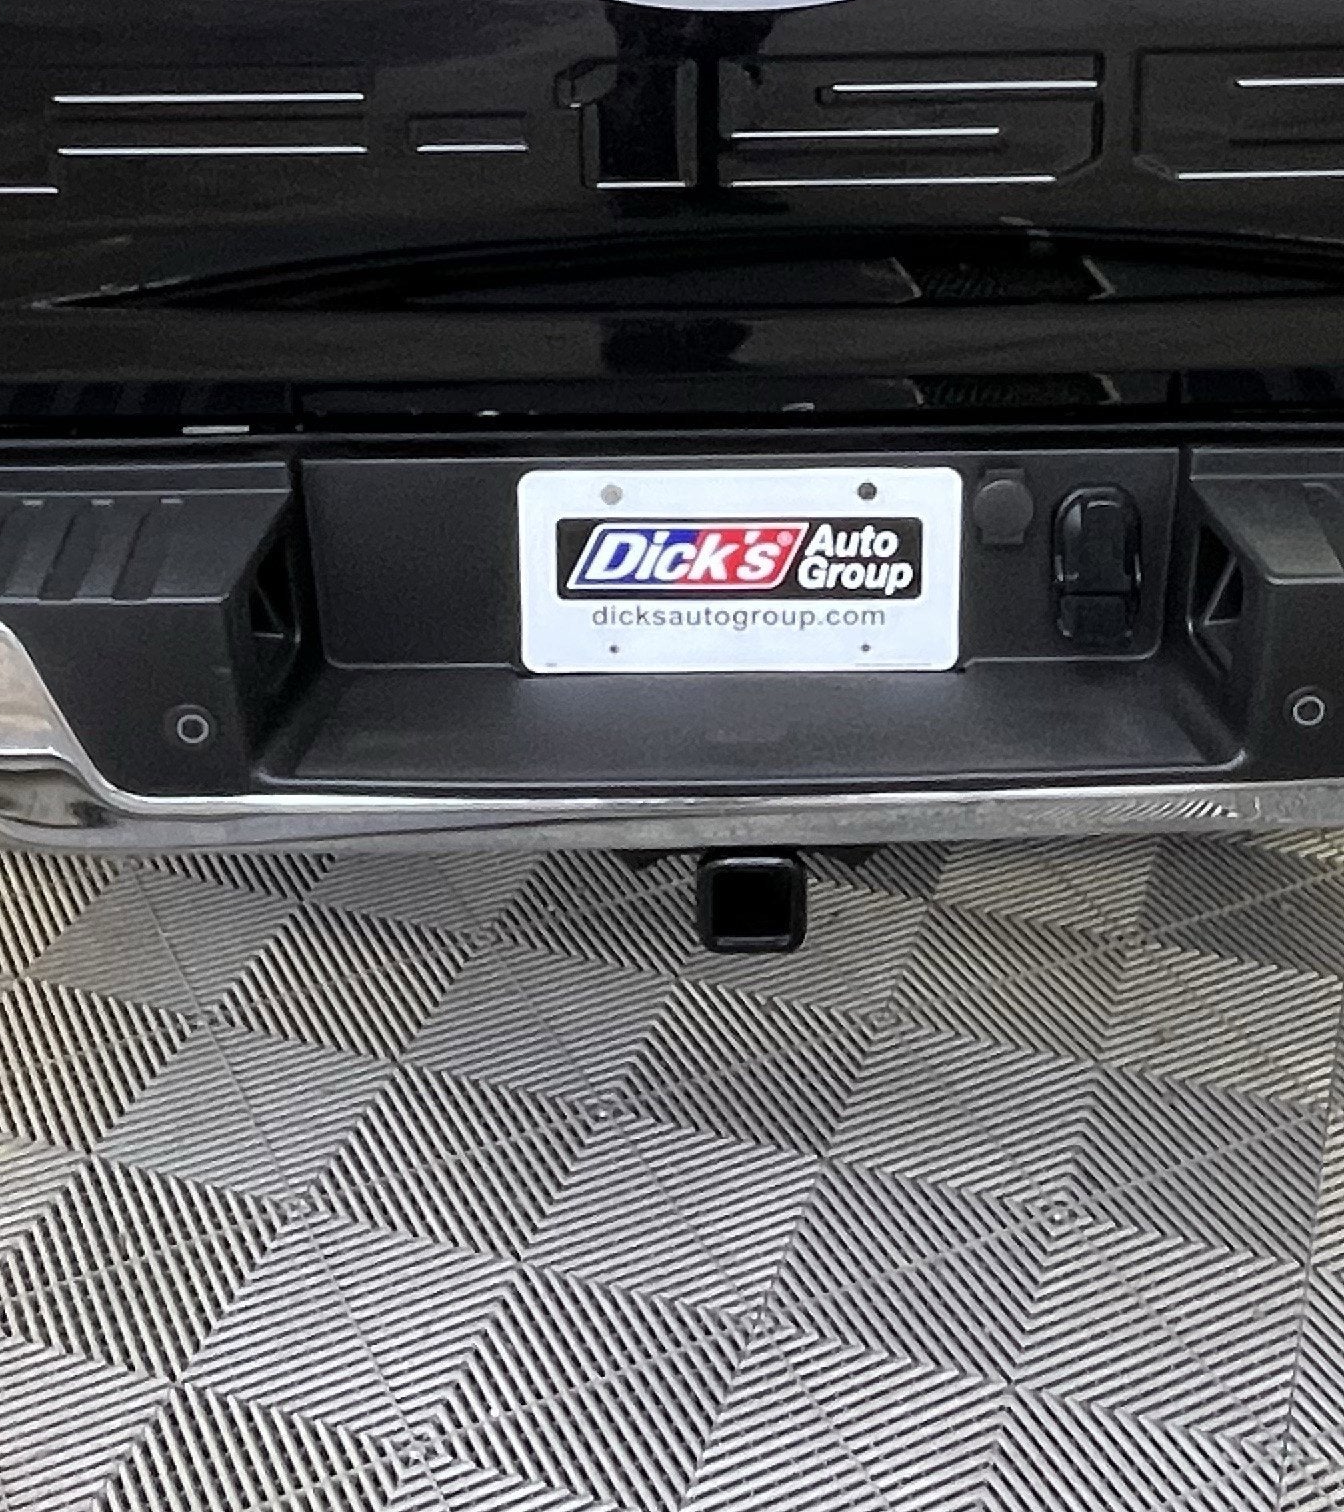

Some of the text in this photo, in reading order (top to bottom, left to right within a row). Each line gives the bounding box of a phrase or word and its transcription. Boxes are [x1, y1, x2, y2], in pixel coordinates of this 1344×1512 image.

[804, 524, 899, 558] Auto
[797, 556, 914, 595] Group
[592, 605, 886, 631] dicksautogroup.com
